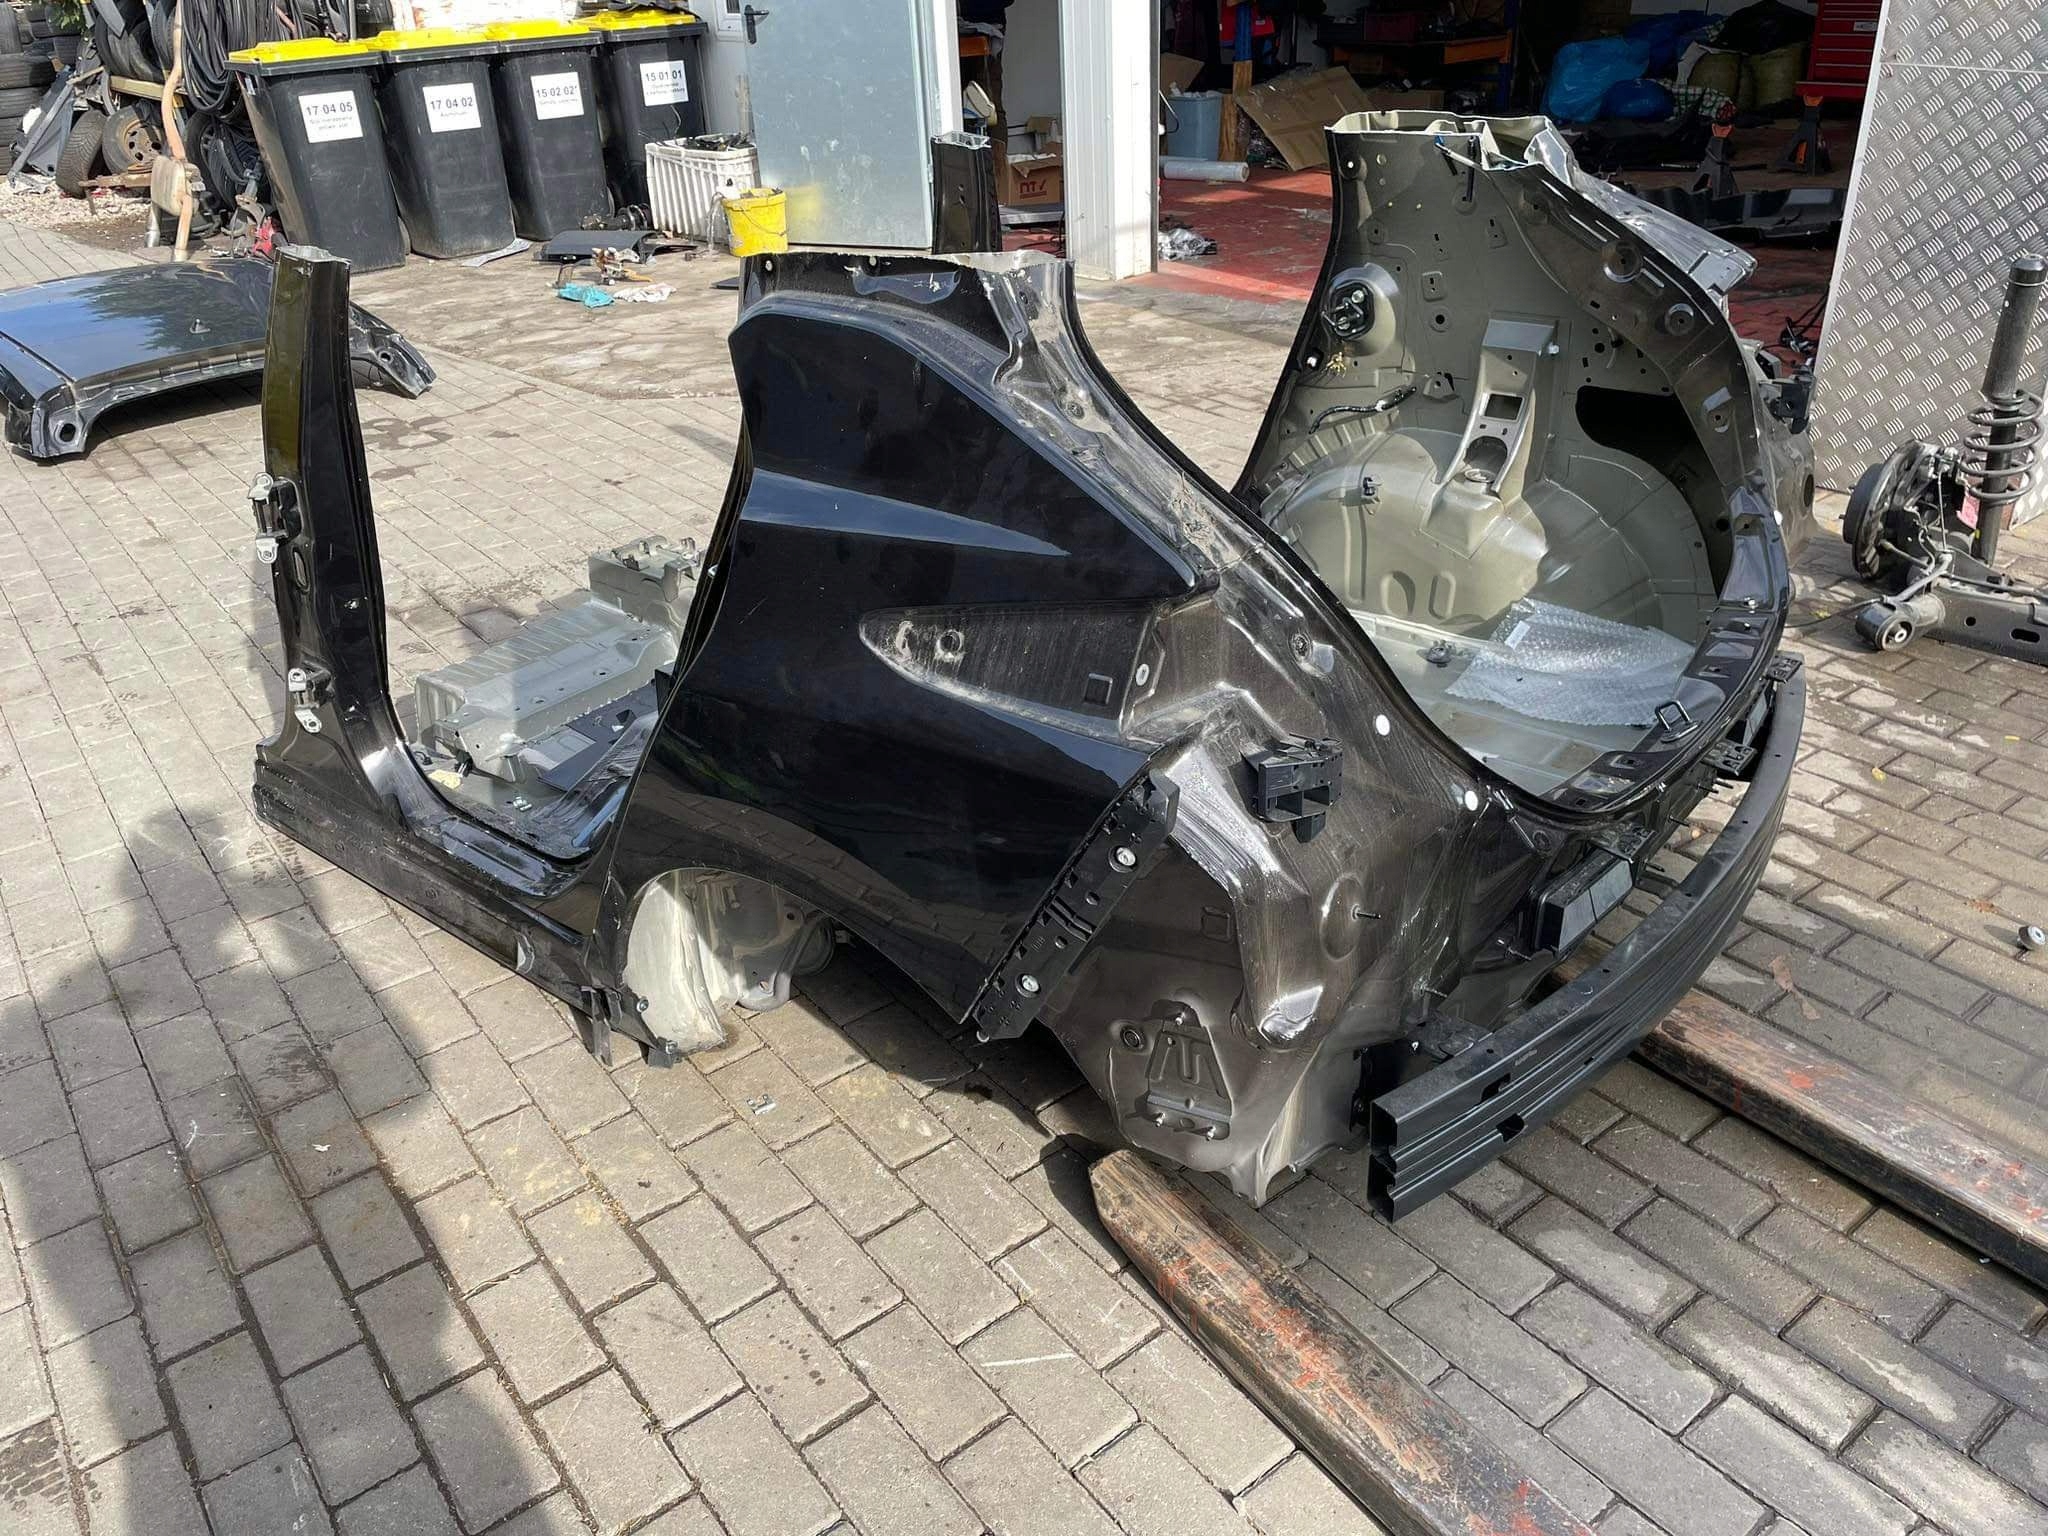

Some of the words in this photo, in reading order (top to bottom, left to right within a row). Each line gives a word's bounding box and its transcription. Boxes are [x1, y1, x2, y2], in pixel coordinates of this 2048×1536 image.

[645, 72, 657, 82] 15
[658, 71, 669, 81] 01
[671, 69, 682, 80] 01
[536, 88, 548, 98] 15
[306, 105, 319, 116] 17
[322, 103, 337, 115] 04
[339, 101, 353, 113] 05
[430, 99, 442, 110] 17
[445, 98, 459, 109] 04
[461, 96, 473, 107] 02
